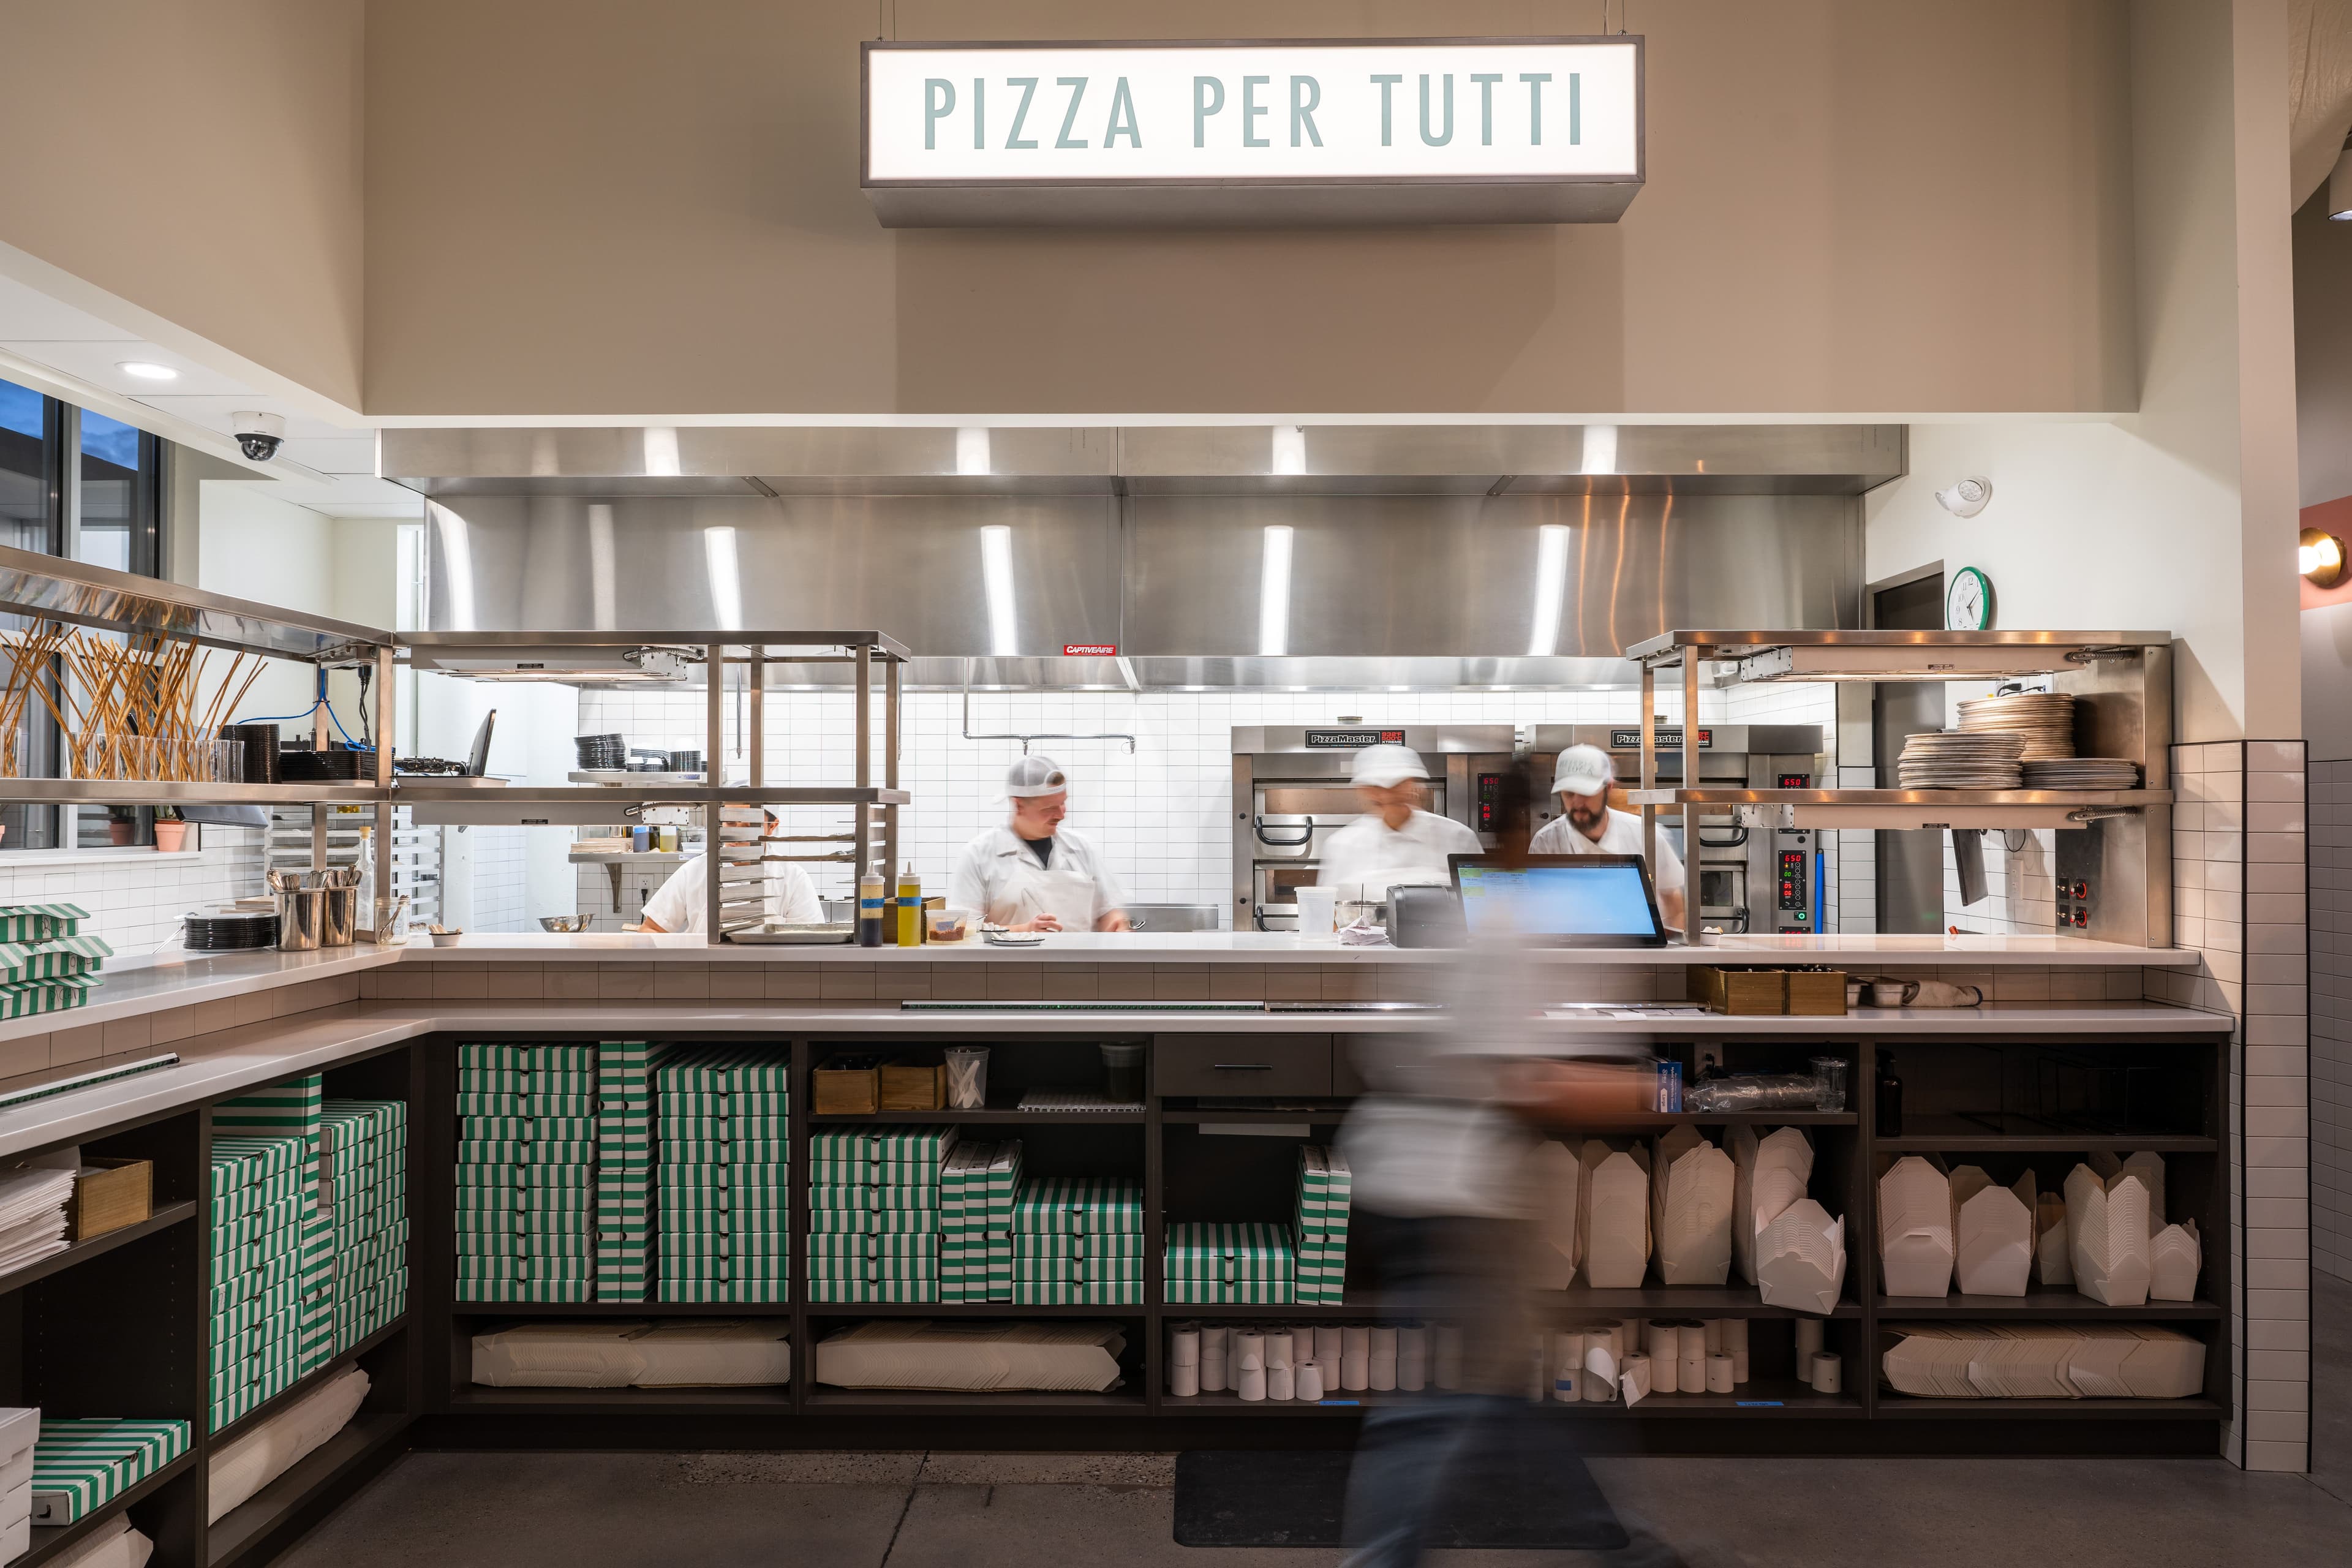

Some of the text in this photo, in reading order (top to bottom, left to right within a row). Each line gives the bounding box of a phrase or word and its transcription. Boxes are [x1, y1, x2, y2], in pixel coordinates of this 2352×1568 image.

[925, 74, 1580, 149] PIZZA PER TUTTI
[1968, 577, 1973, 586] 12
[1962, 582, 1967, 591] 11
[1956, 605, 1961, 614] 9
[1958, 617, 1962, 626] 8
[1311, 734, 1376, 743] PizzaMaster
